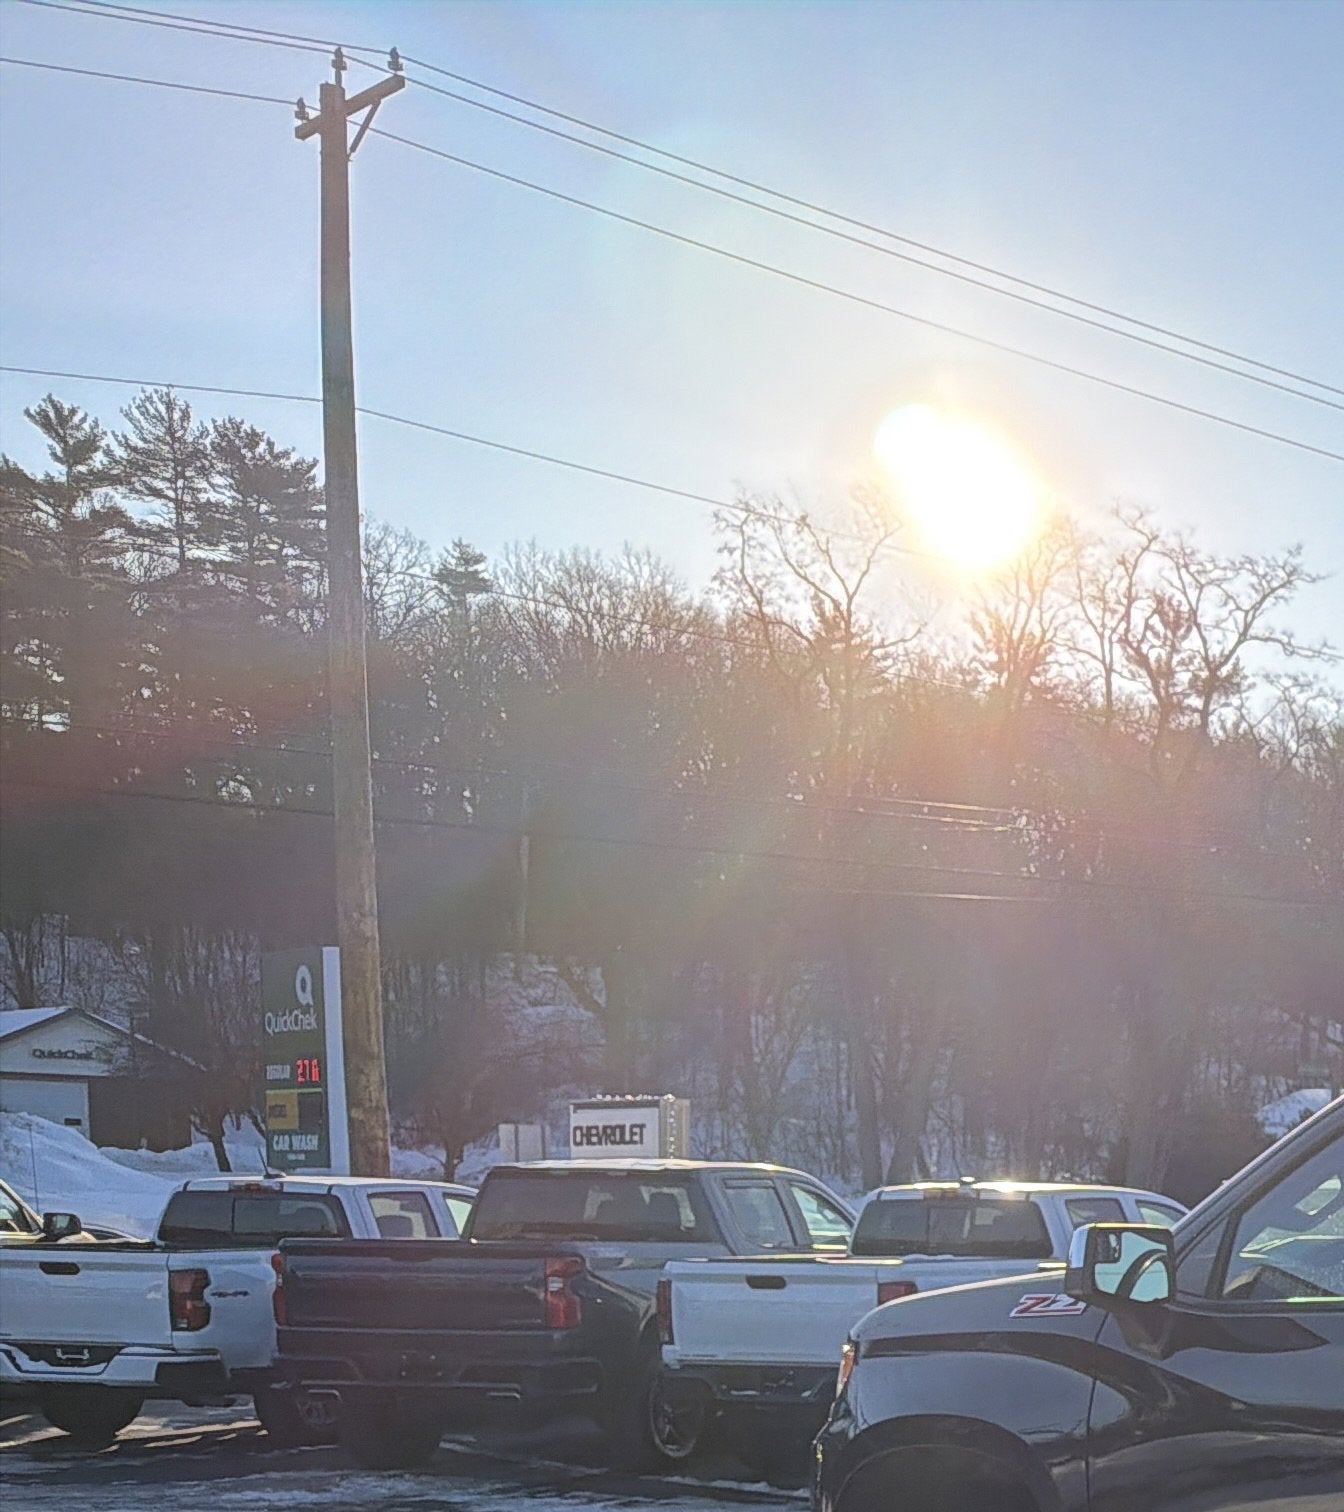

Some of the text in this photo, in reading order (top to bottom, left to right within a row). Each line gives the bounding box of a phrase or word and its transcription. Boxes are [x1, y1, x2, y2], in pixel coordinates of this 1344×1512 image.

[264, 1008, 318, 1036] QuickChek
[292, 1134, 319, 1151] WASH
[572, 1123, 646, 1147] CHEVROLET
